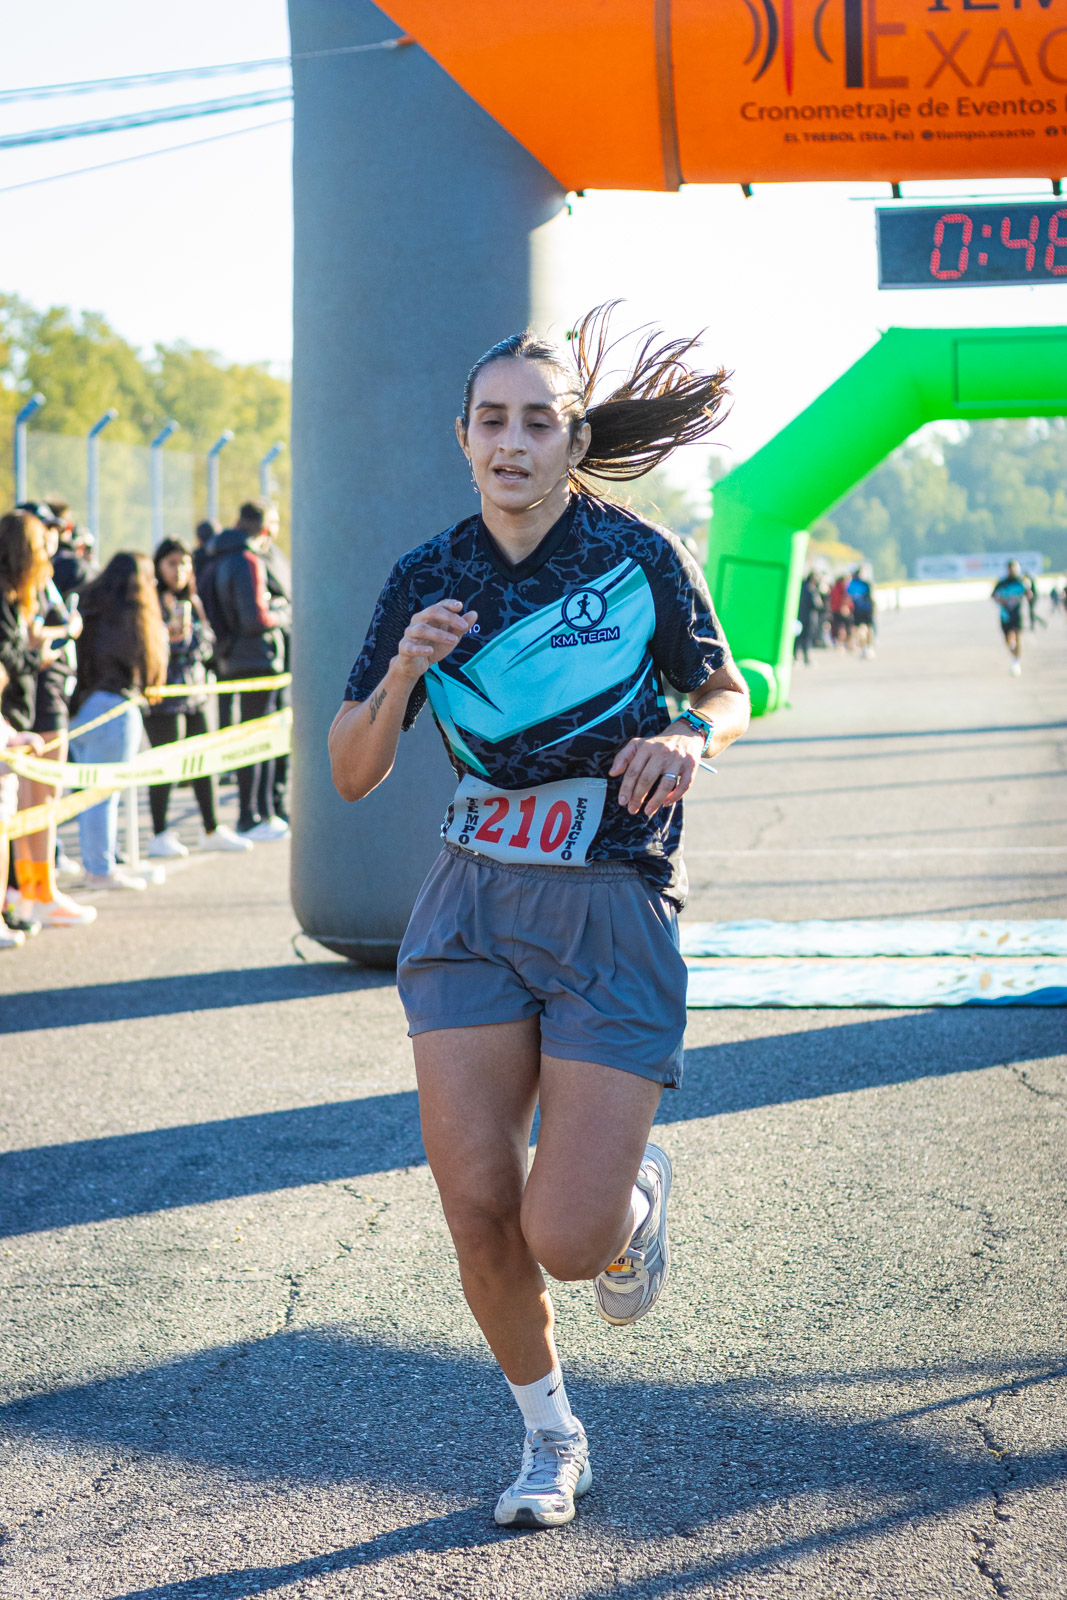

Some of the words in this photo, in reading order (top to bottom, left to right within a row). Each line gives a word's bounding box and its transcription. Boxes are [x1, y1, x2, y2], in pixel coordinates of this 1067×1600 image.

[740, 100, 911, 123] Cronometraje
[917, 99, 949, 117] de
[957, 96, 1057, 117] Eventos
[551, 633, 578, 648] KM.
[579, 627, 620, 645] TEAM
[474, 795, 573, 854] 210
[560, 797, 588, 861] EXACTO
